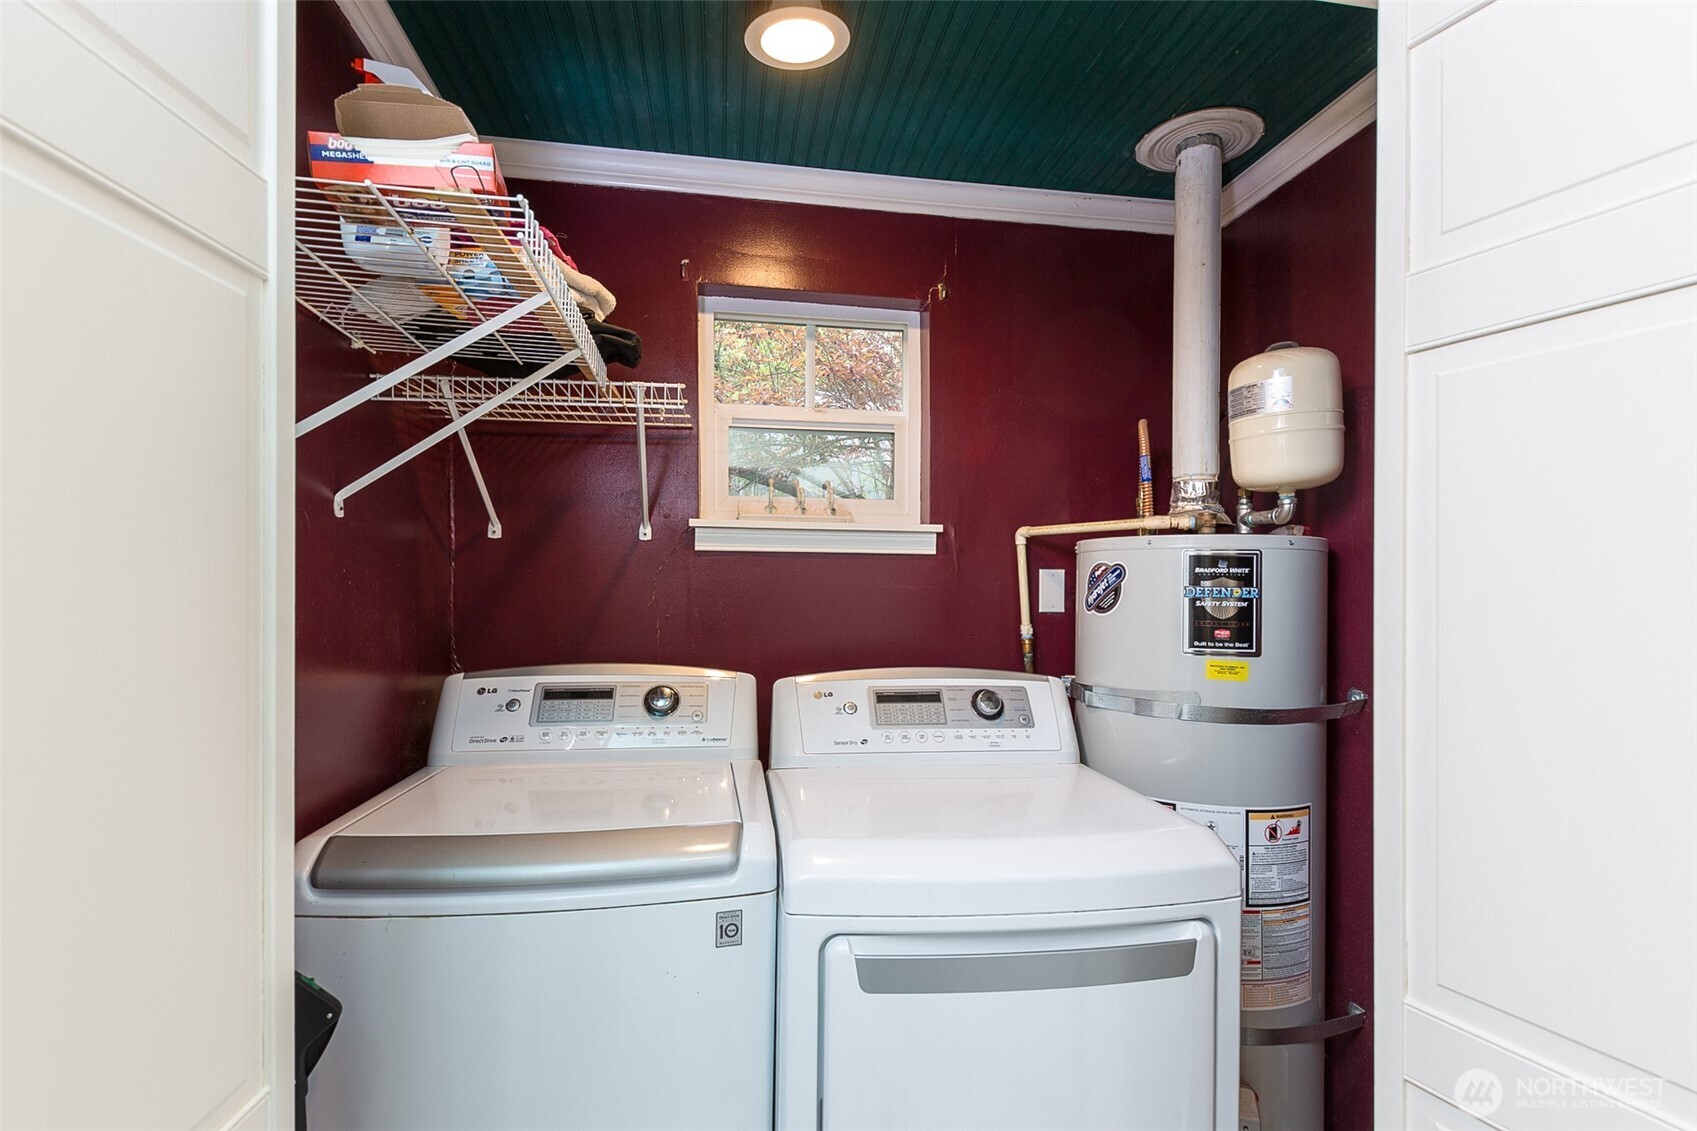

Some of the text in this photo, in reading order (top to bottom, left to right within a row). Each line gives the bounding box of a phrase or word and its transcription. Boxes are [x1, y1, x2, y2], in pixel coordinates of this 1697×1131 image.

[328, 137, 353, 150] bou
[321, 150, 370, 160] MEGASHE
[1184, 586, 1260, 599] DEFENDER
[720, 923, 739, 939] 10
